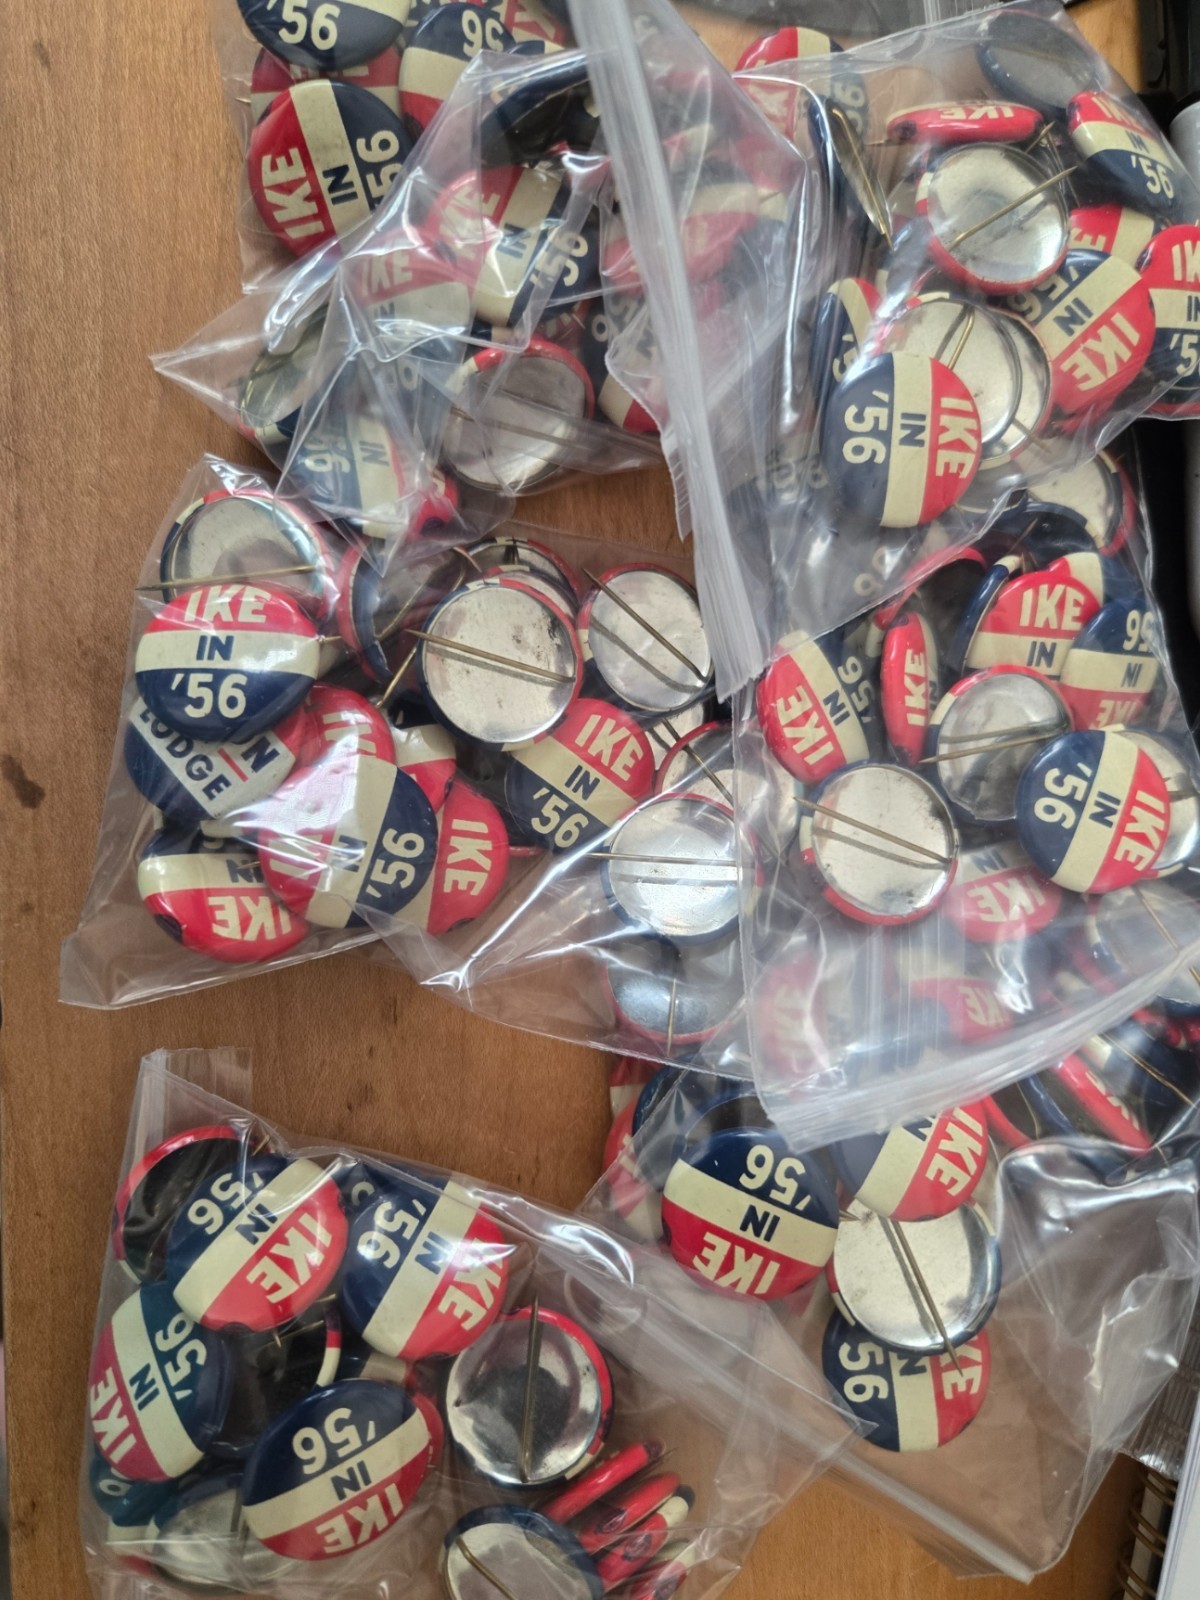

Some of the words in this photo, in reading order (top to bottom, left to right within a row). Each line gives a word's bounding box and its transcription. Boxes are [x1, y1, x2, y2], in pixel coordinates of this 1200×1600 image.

[266, 0, 340, 50] '56
[938, 105, 1014, 120] IKE
[261, 148, 325, 239] IKE
[322, 164, 359, 205] IN
[1131, 155, 1174, 198] '56
[495, 222, 531, 259] IN
[529, 231, 588, 288] '56
[1172, 240, 1200, 282] IK
[361, 252, 413, 297] IKE
[1052, 298, 1094, 337] IN
[1060, 312, 1140, 392] IKE
[1169, 333, 1200, 377] '5
[842, 390, 889, 464] '56
[899, 412, 926, 447] IN
[935, 397, 979, 479] IKE
[359, 440, 390, 466] IN
[184, 584, 271, 623] IKE
[1019, 584, 1085, 630] IKE
[196, 635, 234, 661] IN
[1026, 641, 1056, 668] IN
[171, 673, 248, 718] '56
[837, 656, 875, 723] '56
[904, 649, 926, 726] IKE
[1120, 663, 1142, 688] IN
[776, 685, 834, 765] IKE
[823, 690, 851, 727] IN
[574, 714, 644, 781] IKE
[564, 765, 600, 801] IN
[1034, 762, 1092, 830] '56
[531, 787, 588, 848] '56
[1089, 790, 1122, 829] IN
[1113, 790, 1168, 871] IKE
[366, 828, 425, 898] '56
[443, 819, 492, 896] IKE
[970, 849, 1007, 873] IN
[208, 895, 292, 941] IKE
[966, 874, 1046, 922] IKE
[925, 1106, 983, 1196] IKE
[739, 1144, 812, 1211] '56
[187, 1172, 264, 1235] '56
[234, 1202, 278, 1246] IN
[739, 1204, 780, 1242] IN
[357, 1199, 427, 1269] '56
[245, 1213, 332, 1304] IKE
[692, 1231, 780, 1295] IKE
[154, 1312, 207, 1400] '56
[129, 1363, 160, 1411] IN
[90, 1366, 137, 1464] IKE
[292, 1407, 375, 1475] '56
[330, 1460, 371, 1501] IN
[315, 1482, 403, 1554] IKE
